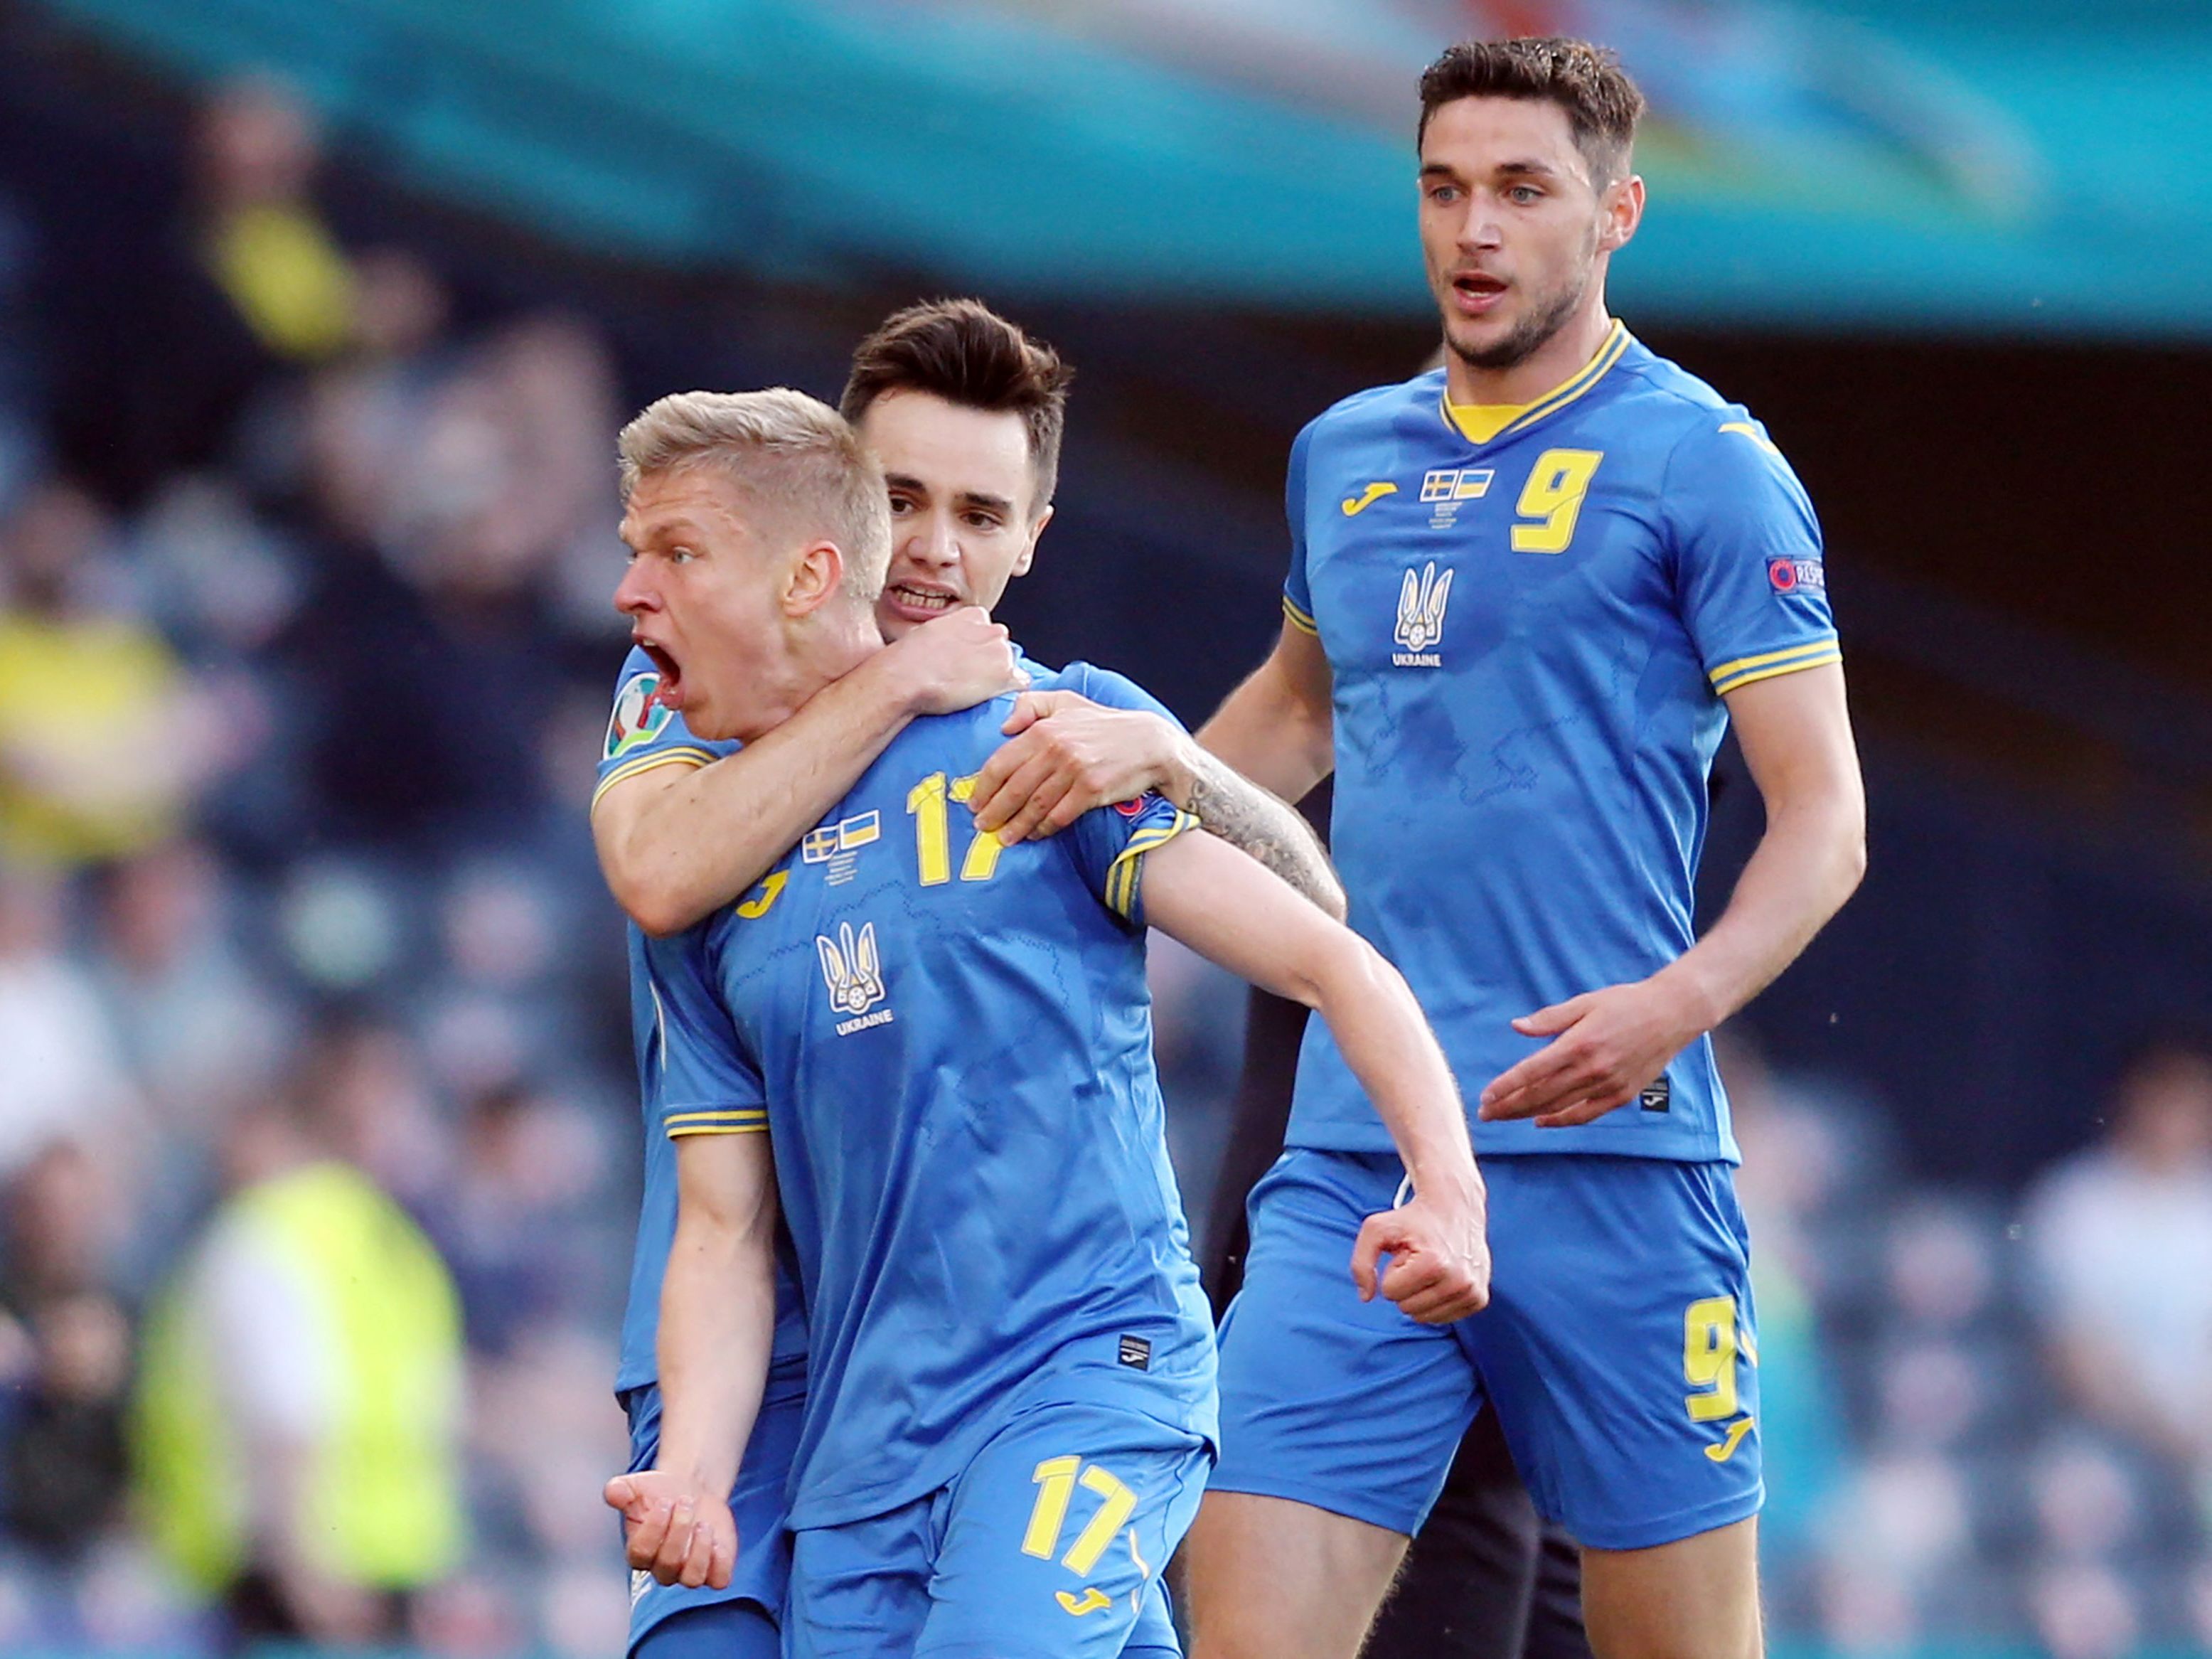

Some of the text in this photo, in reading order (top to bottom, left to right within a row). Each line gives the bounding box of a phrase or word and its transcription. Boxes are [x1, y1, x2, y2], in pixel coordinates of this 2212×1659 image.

[1510, 448, 1603, 554] 9
[1392, 654, 1441, 667] UKRAINE
[836, 1008, 894, 1036] UKRAINE
[1684, 1294, 1737, 1422] 9
[1020, 1455, 1138, 1578] 17
